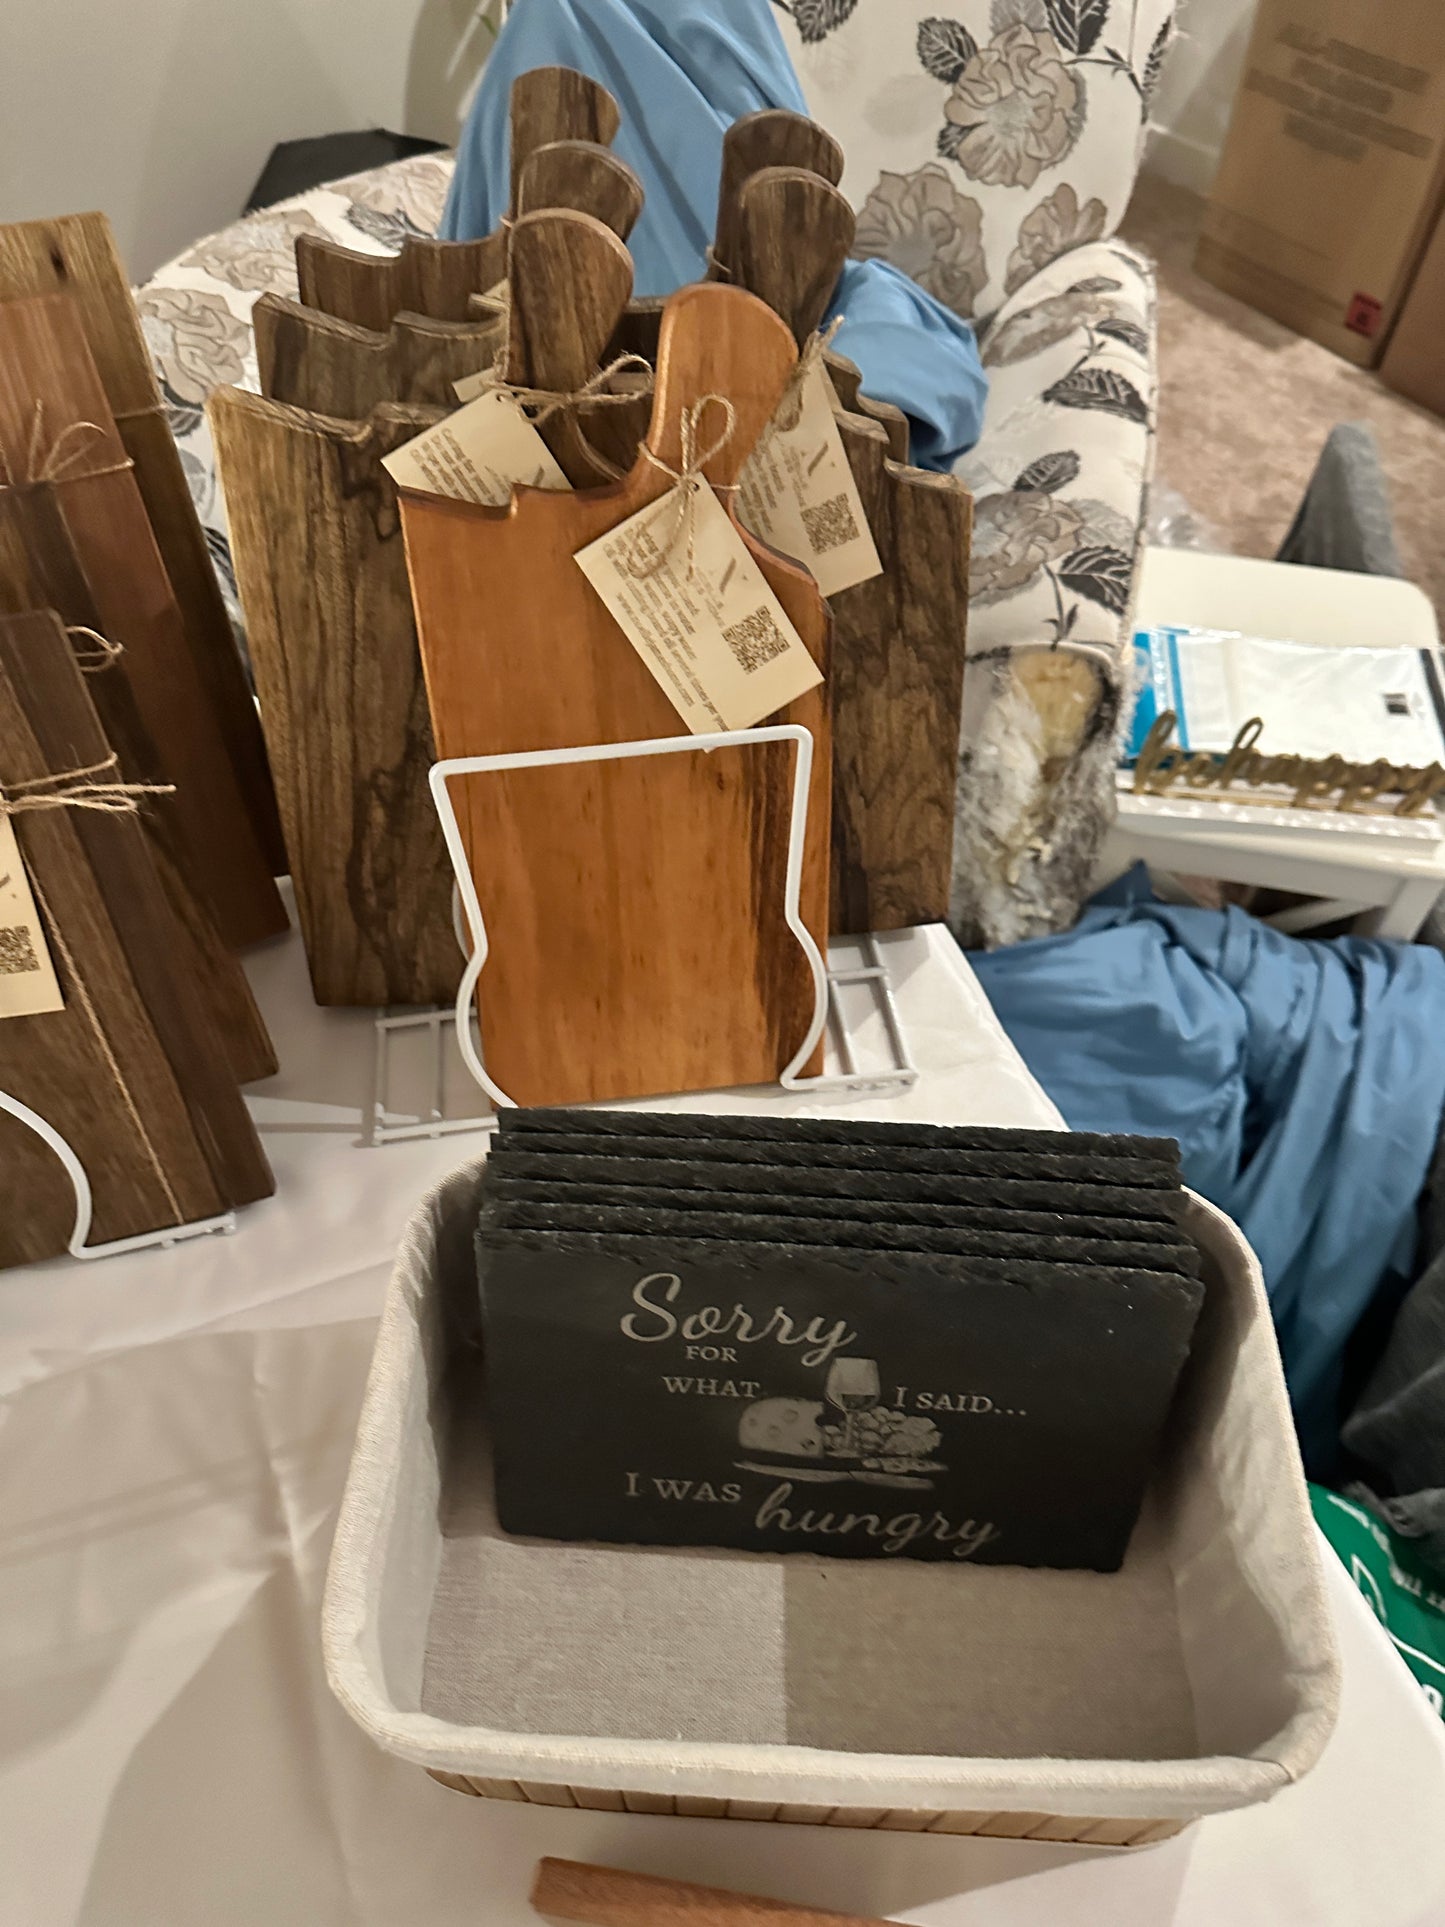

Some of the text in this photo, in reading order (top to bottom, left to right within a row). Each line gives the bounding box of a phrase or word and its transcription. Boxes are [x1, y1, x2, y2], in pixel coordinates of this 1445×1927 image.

[620, 1272, 857, 1367] Sorry
[685, 1345, 738, 1363] FOR
[661, 1375, 760, 1398] WHAT
[894, 1386, 909, 1407] I
[625, 1472, 1000, 1557] I WAS hungry
